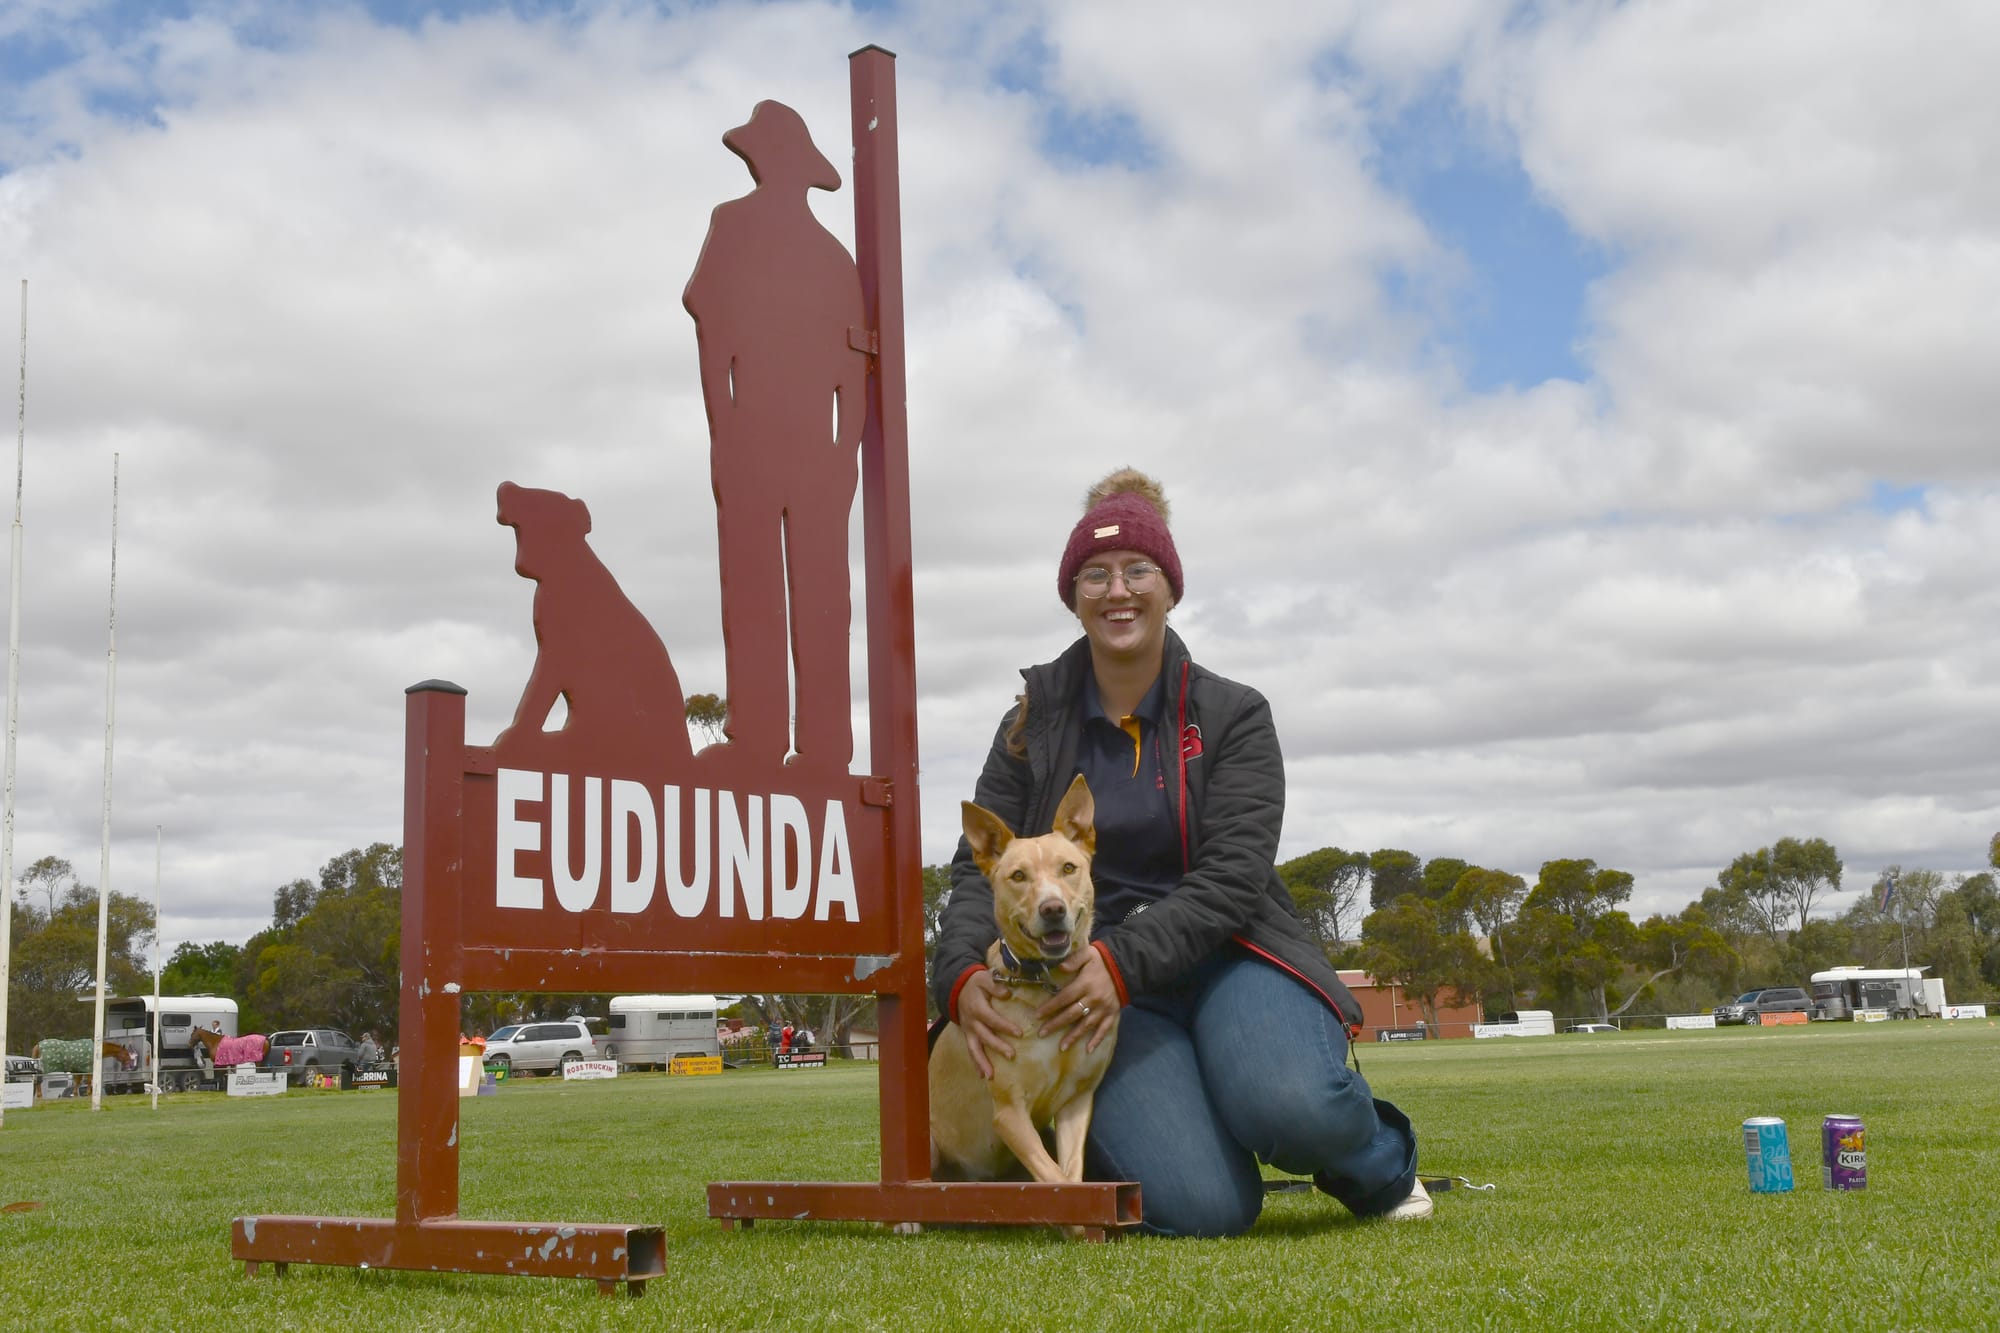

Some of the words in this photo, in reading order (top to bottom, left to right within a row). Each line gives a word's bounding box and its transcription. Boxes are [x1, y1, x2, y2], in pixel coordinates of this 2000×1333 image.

[497, 768, 860, 922] EUDUNDA
[778, 1055, 789, 1063] TC
[567, 1065, 584, 1075] ROSS
